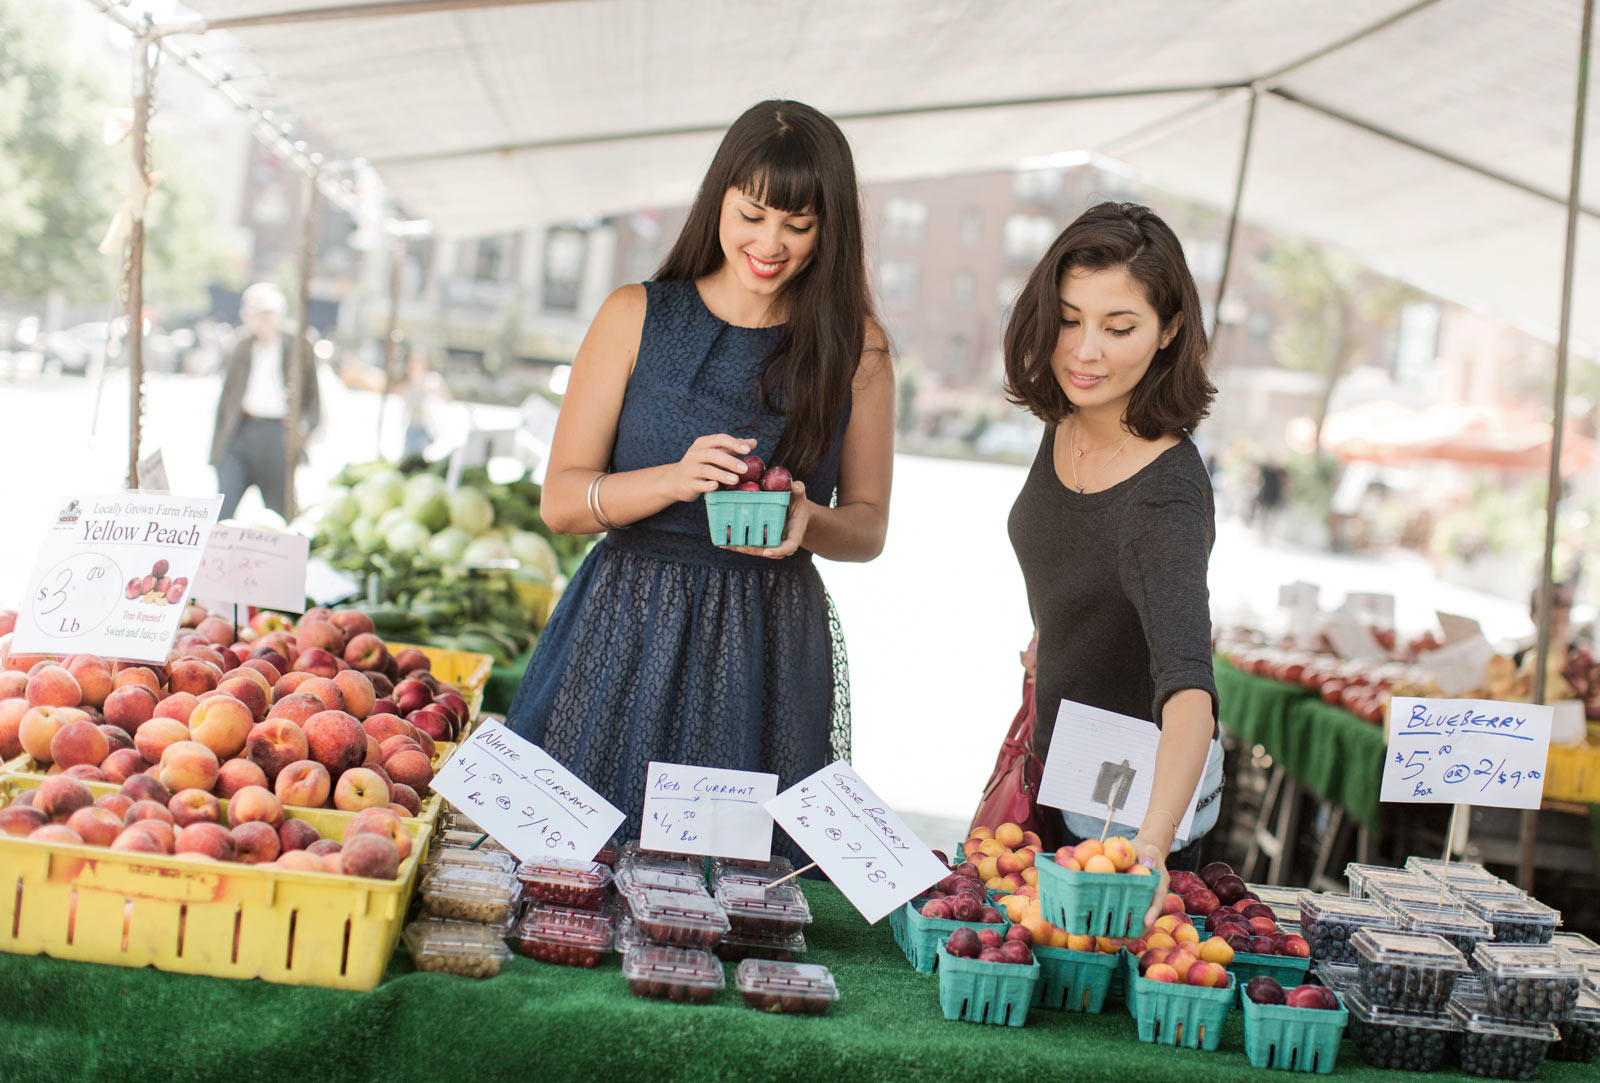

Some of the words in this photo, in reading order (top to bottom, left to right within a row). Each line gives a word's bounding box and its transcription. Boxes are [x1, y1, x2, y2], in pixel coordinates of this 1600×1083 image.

[93, 503, 122, 516] Locally
[125, 503, 155, 515] Grown
[156, 504, 180, 517] Farm
[182, 506, 208, 519] Fresh
[82, 520, 140, 541] Yellow
[143, 522, 200, 546] Peach
[123, 610, 136, 620] Tree
[59, 618, 80, 632] Lb
[104, 625, 125, 636] Sweet
[125, 627, 140, 638] and
[139, 628, 158, 641] Juicy
[476, 729, 520, 761] WHITE
[534, 768, 598, 816] CURRANT
[693, 777, 755, 795] CURRANT
